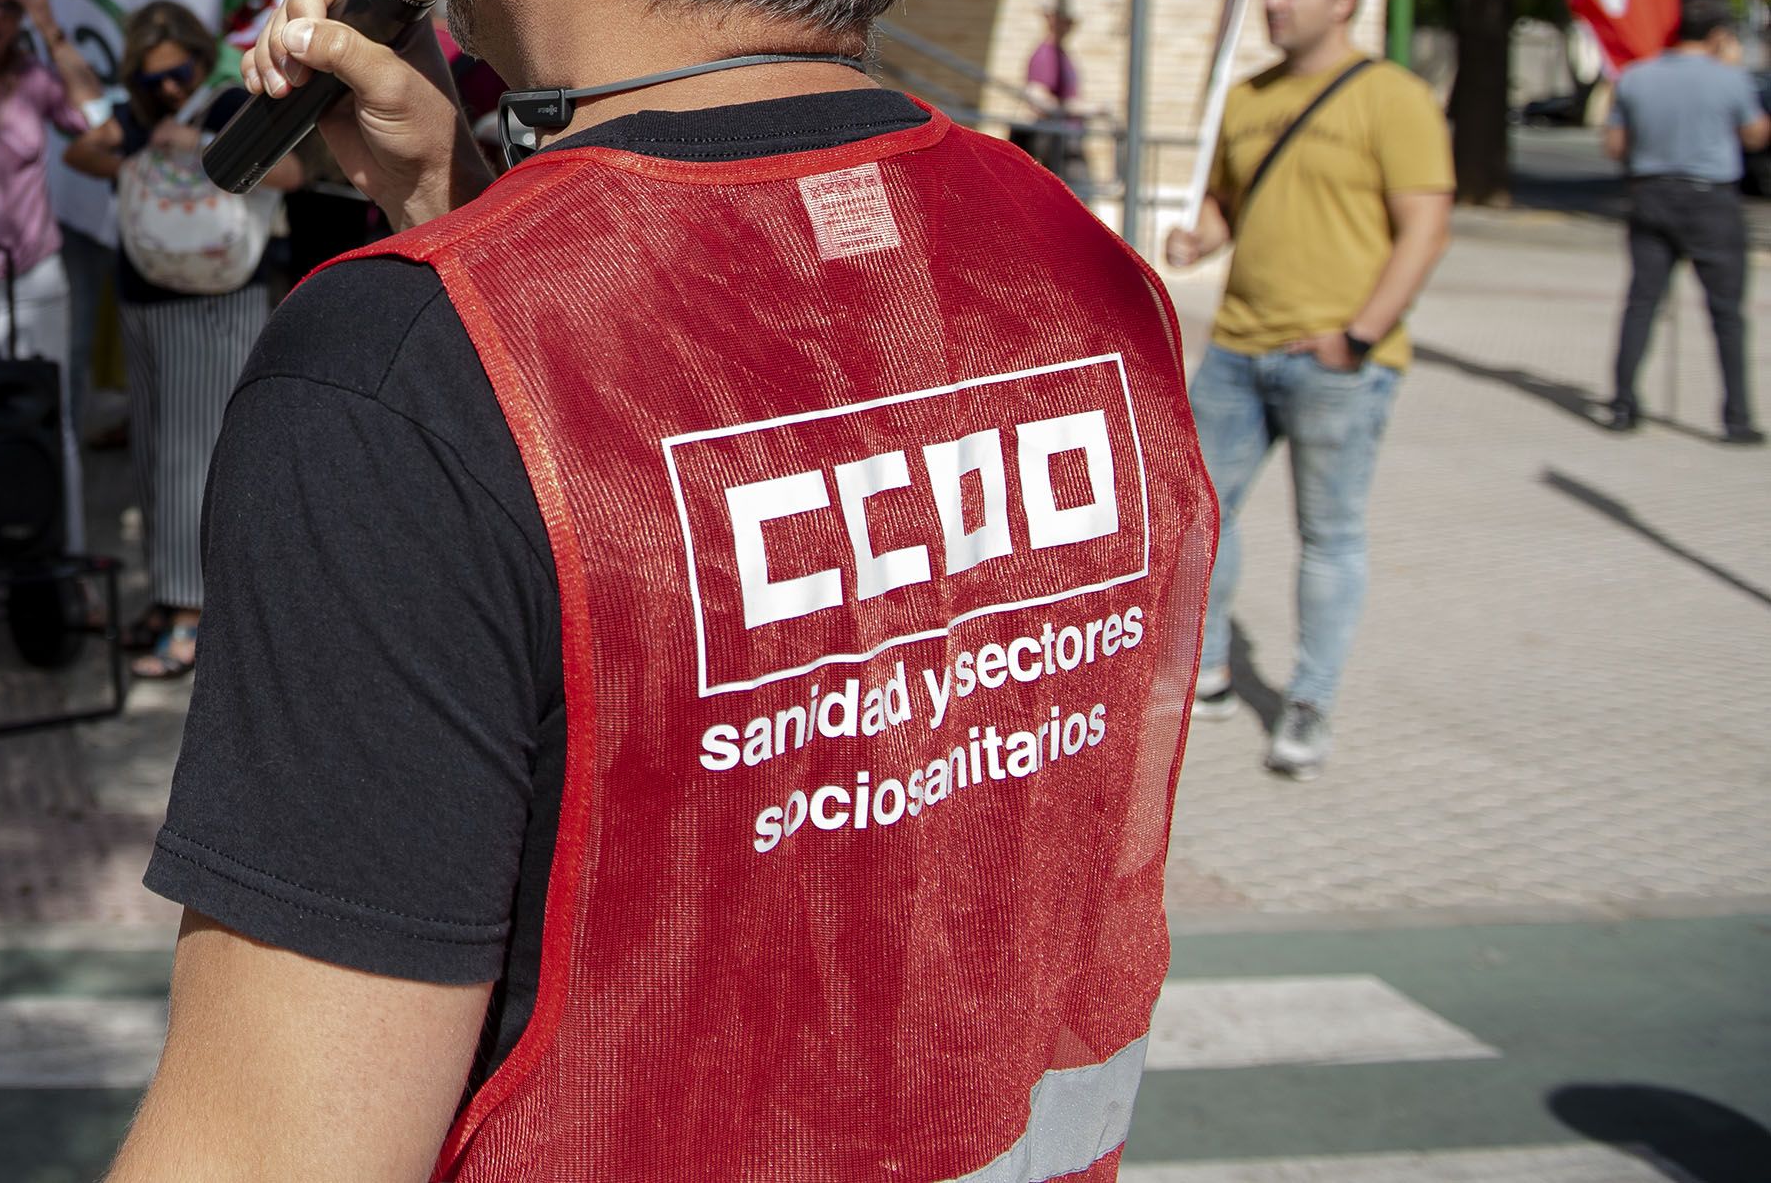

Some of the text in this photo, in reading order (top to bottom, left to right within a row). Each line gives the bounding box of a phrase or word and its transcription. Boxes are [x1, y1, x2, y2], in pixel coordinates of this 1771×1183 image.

[724, 409, 1120, 630] CCOO
[699, 662, 911, 771] sanidad
[753, 700, 1107, 854] sociosanitarios
